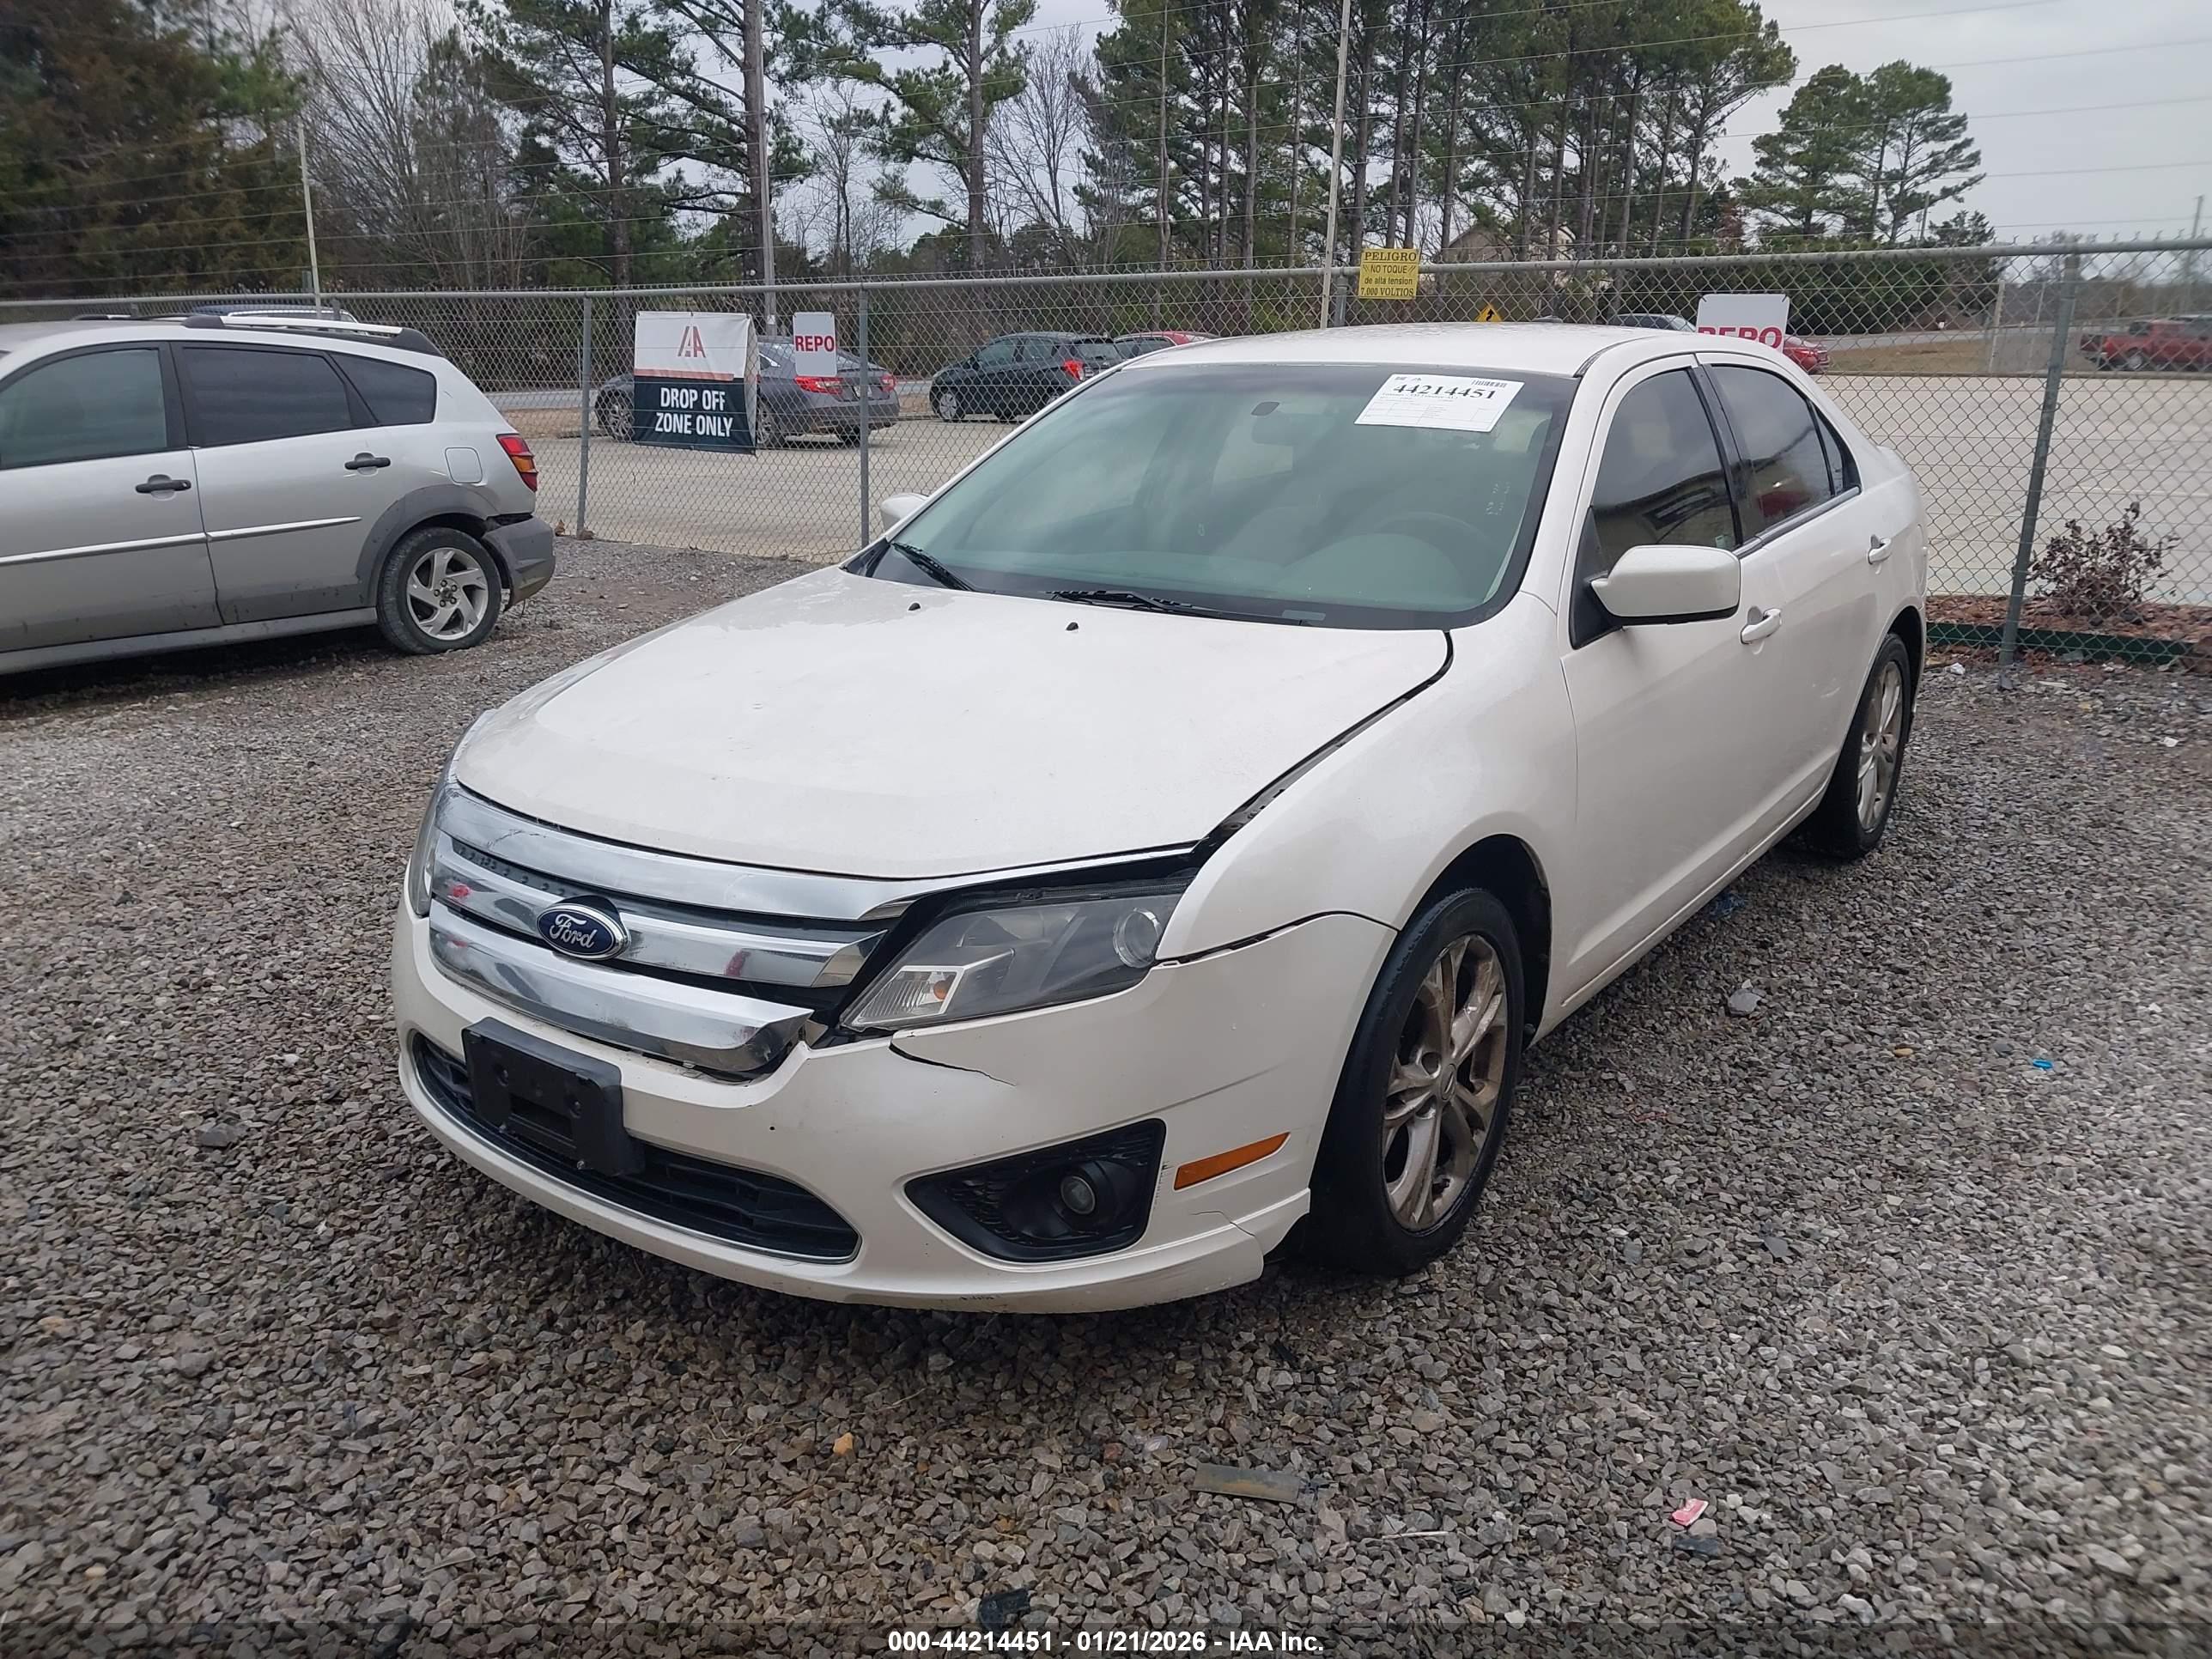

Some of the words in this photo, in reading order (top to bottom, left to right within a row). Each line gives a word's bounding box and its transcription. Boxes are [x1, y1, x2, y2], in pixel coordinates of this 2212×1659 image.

[1364, 252, 1417, 261] PELIGRO
[1383, 265, 1407, 274] TOQUE
[1380, 288, 1414, 296] VOLTIOS
[794, 335, 835, 352] REPO
[659, 387, 698, 409] DROP
[702, 391, 726, 411] OFF
[1393, 384, 1497, 399] 44214451
[654, 412, 692, 434] ZONE
[696, 416, 733, 438] ONLY
[550, 914, 598, 948] Ford
